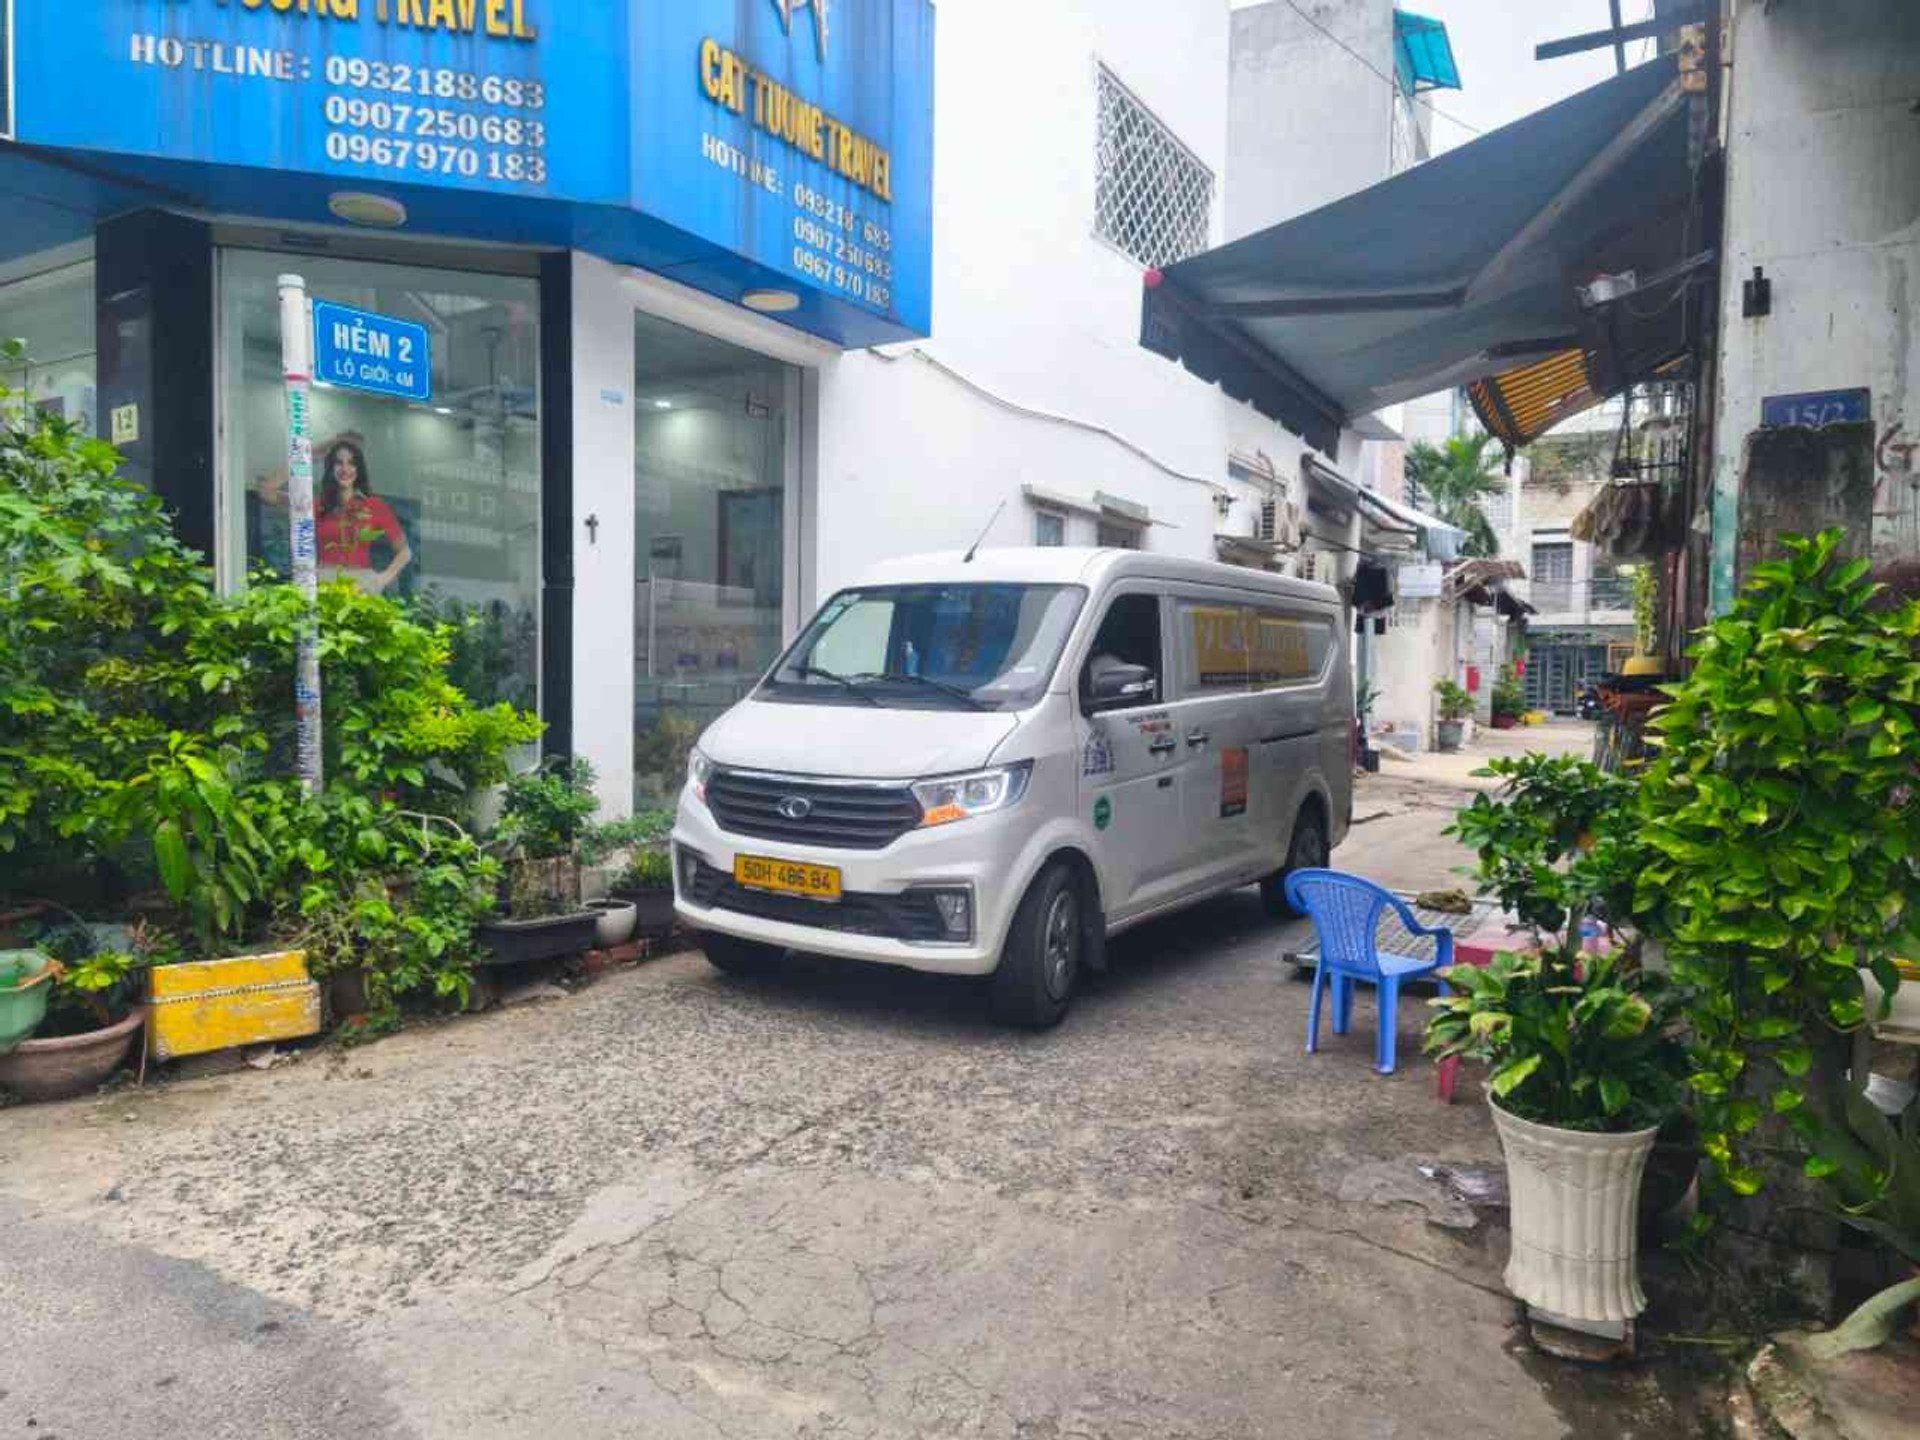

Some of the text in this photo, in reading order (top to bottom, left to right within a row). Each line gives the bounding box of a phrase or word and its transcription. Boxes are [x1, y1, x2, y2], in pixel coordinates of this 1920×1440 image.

[130, 33, 311, 80] HOTLINE:
[333, 317, 413, 363] HẺM 2
